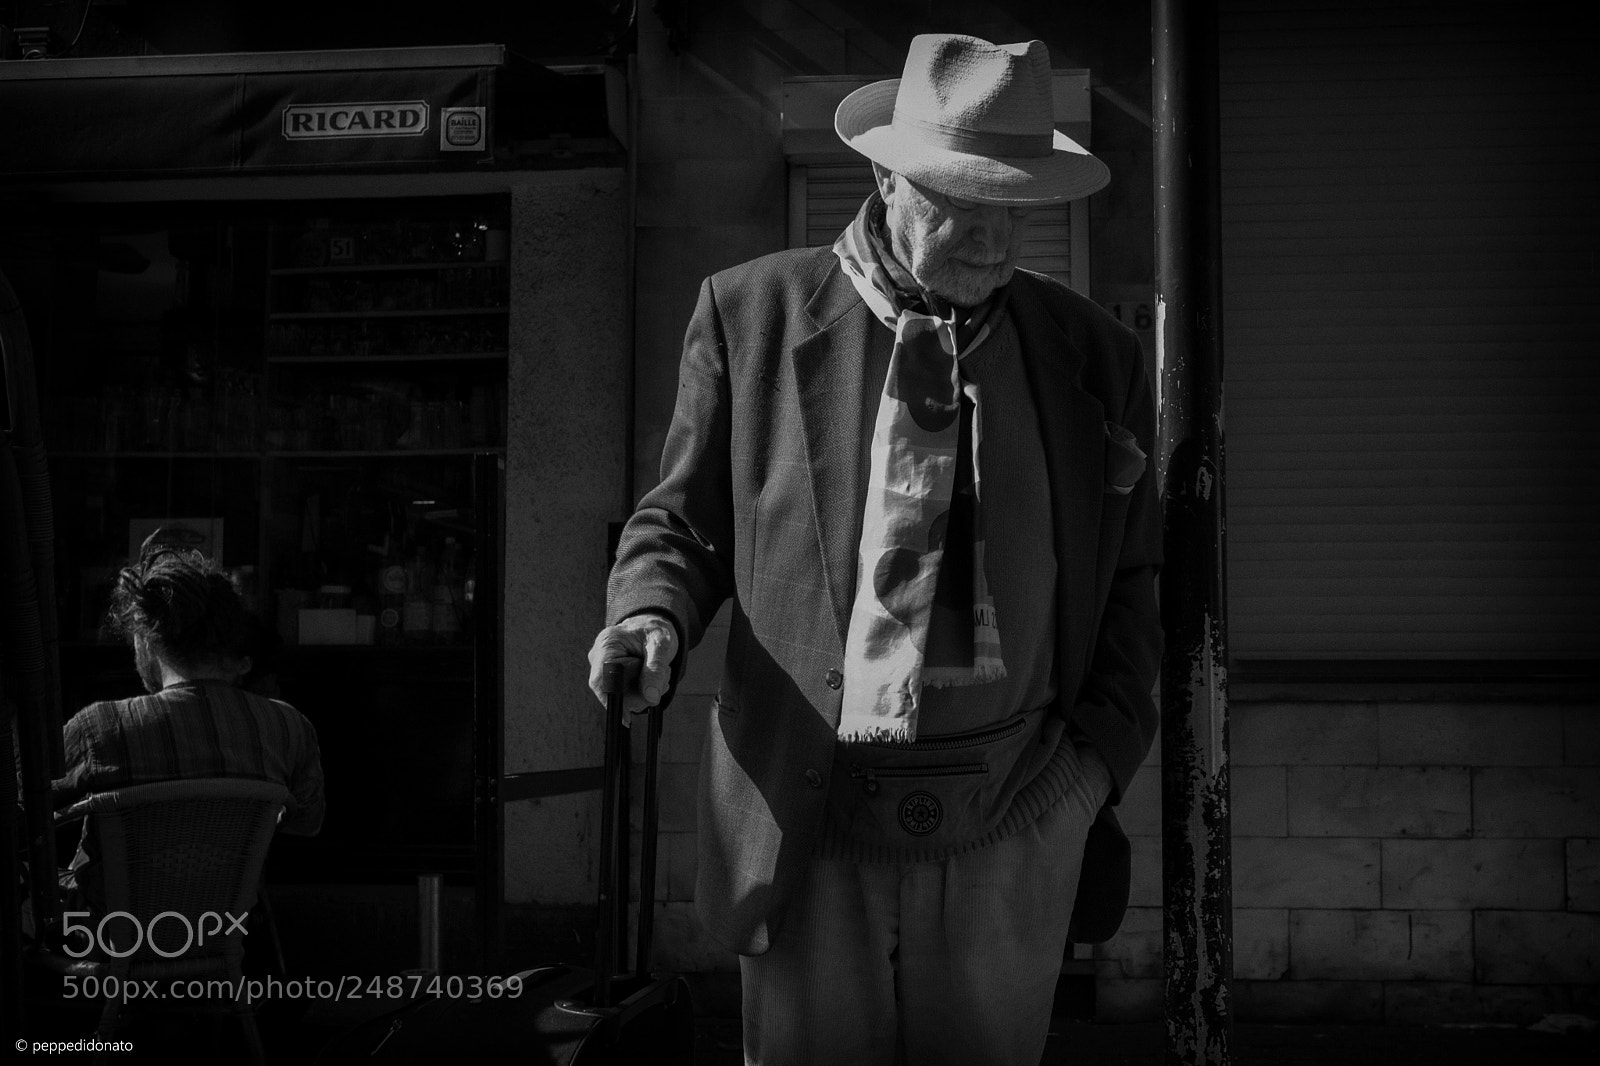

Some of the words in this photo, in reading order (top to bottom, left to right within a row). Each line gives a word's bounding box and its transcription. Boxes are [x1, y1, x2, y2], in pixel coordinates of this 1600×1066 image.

[291, 109, 421, 132] RICARD
[332, 240, 351, 256] 51
[1113, 304, 1153, 330] 16
